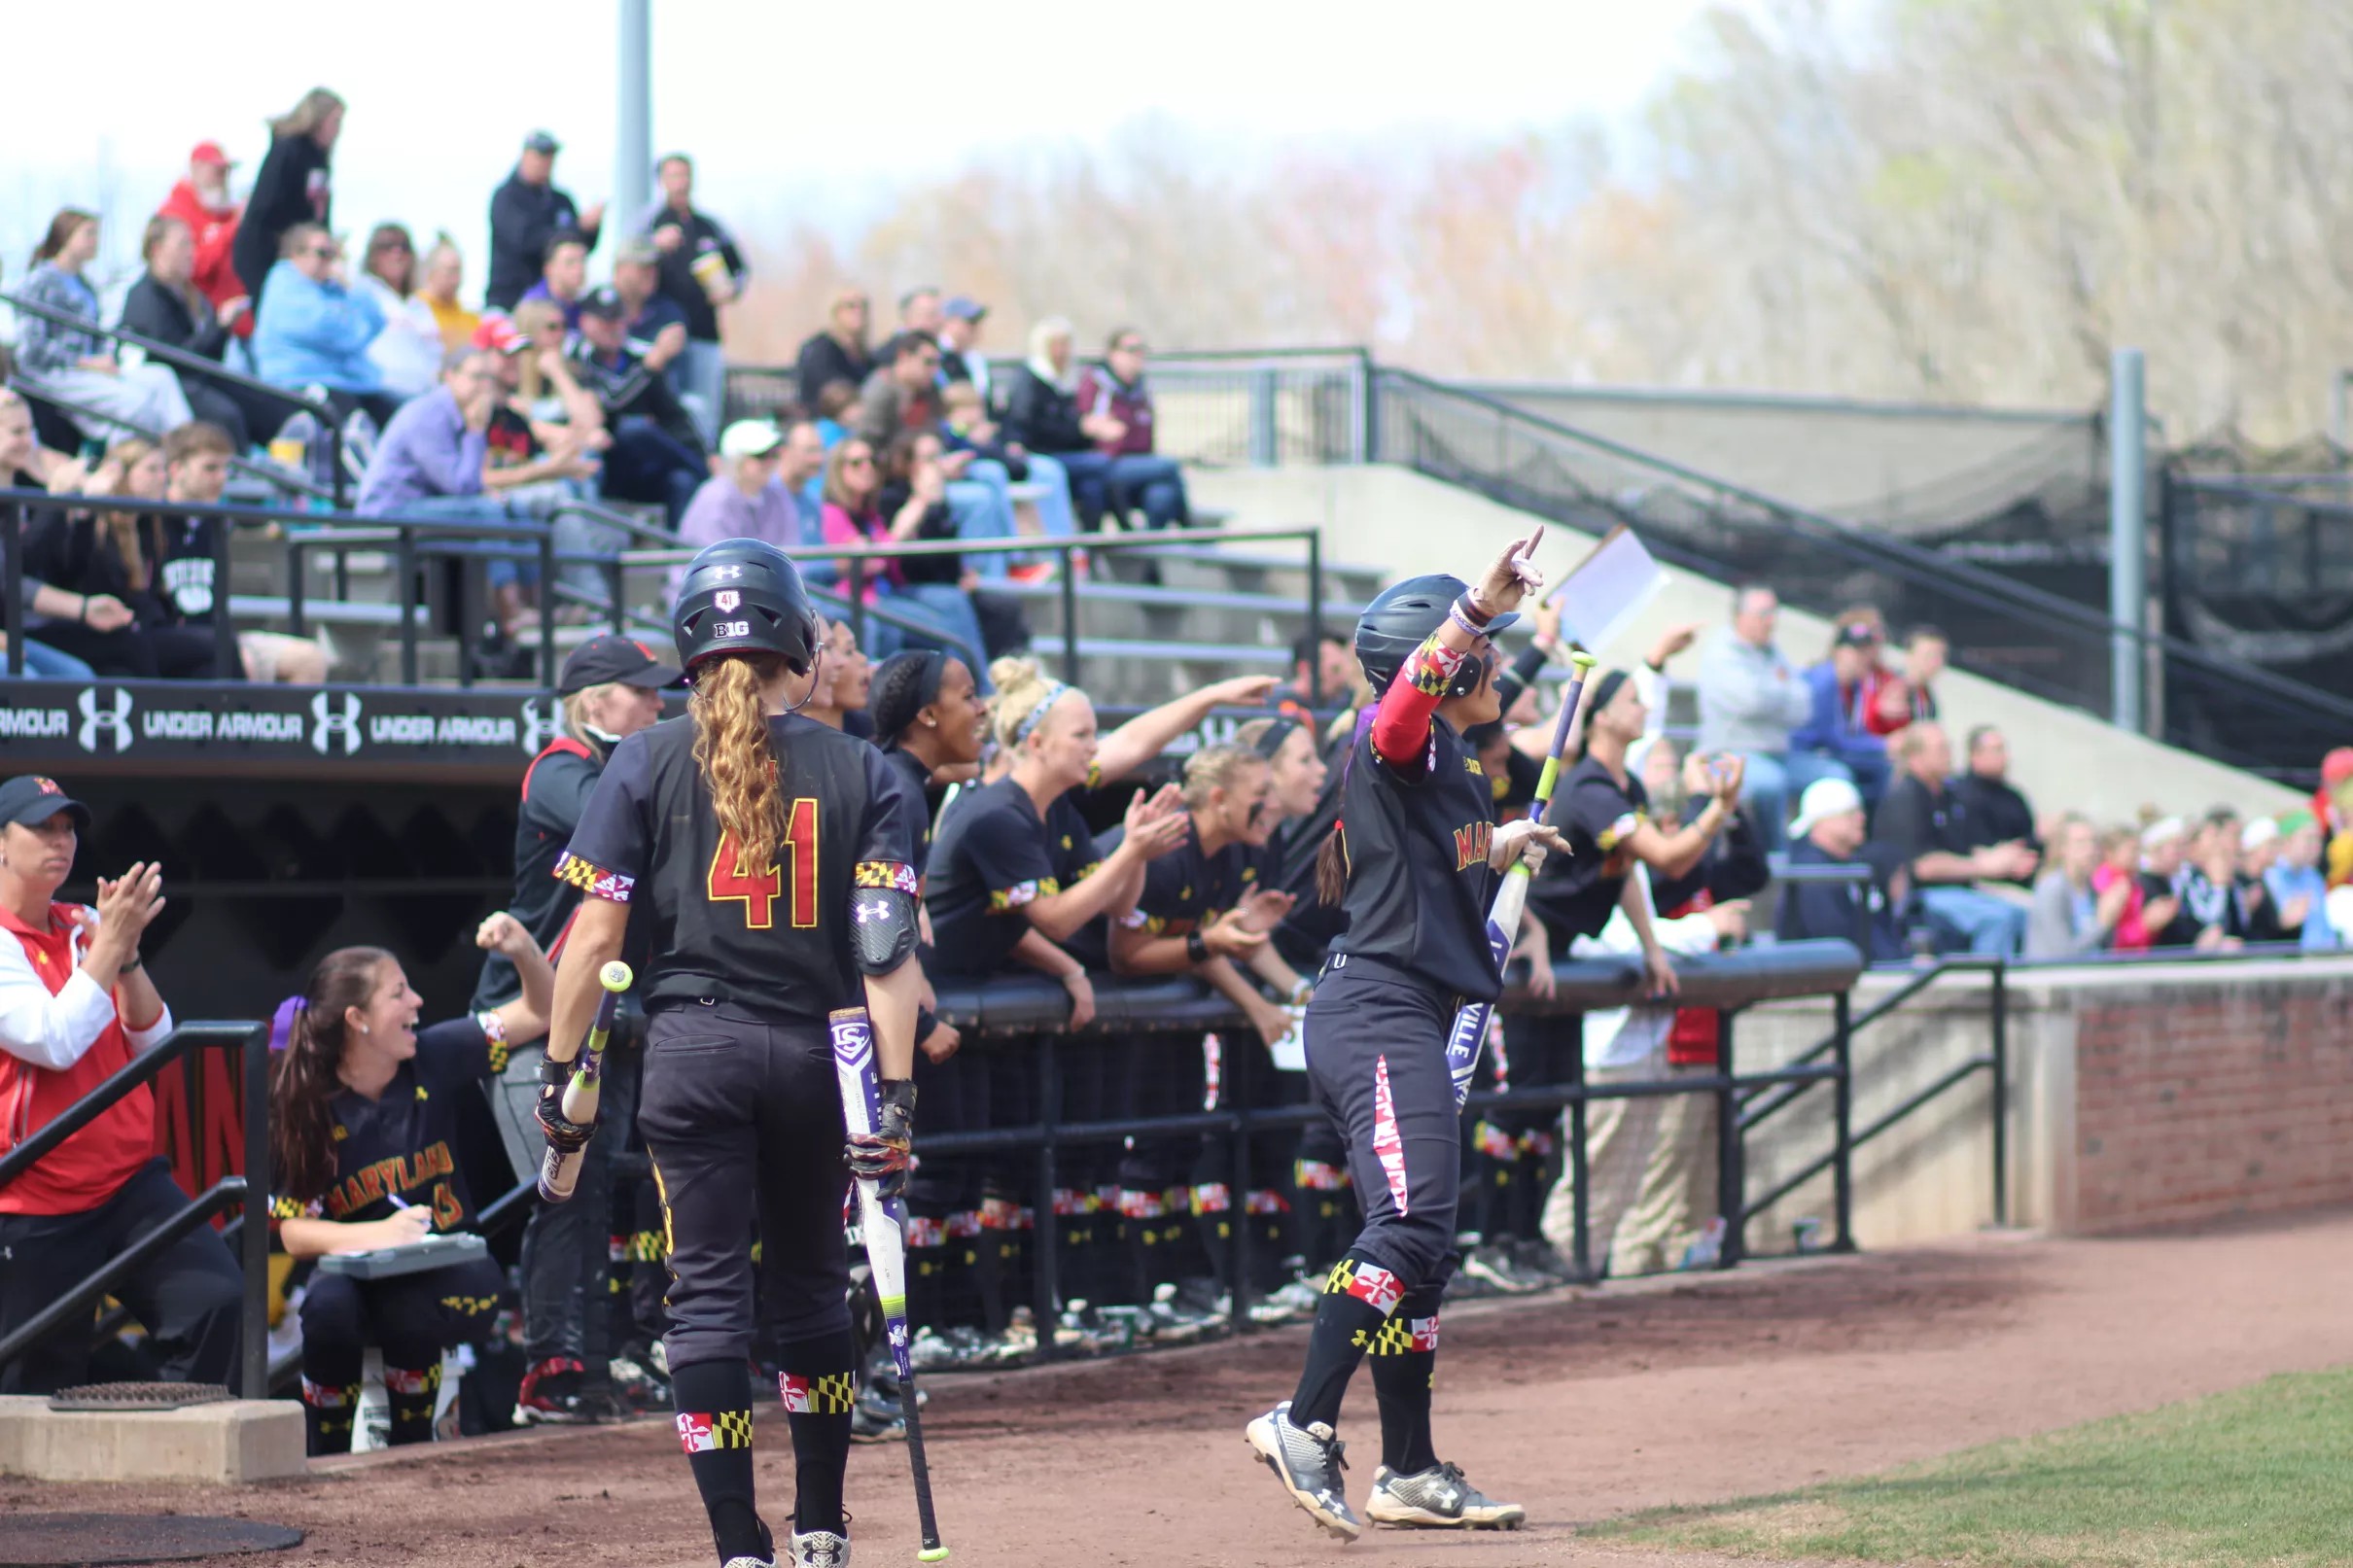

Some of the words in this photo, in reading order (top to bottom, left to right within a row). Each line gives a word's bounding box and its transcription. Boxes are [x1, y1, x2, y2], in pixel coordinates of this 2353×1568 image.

[720, 594, 733, 607] 41
[143, 711, 213, 739] UNDER
[216, 712, 303, 742] ARMOUR
[369, 715, 436, 744] UNDER
[438, 716, 516, 746] ARMOUR
[708, 798, 818, 928] 41
